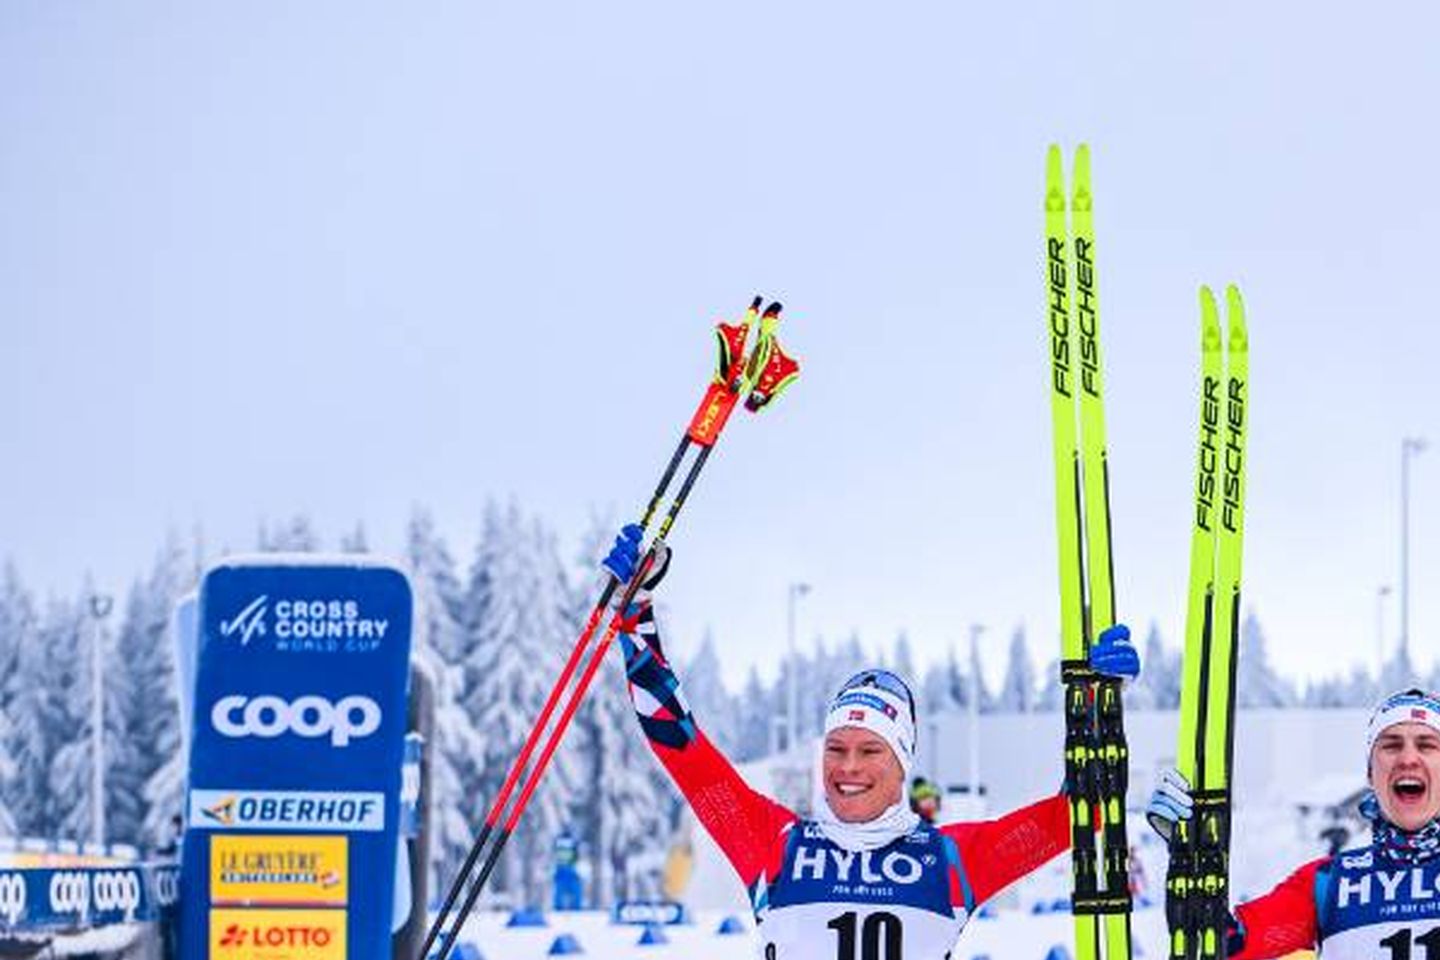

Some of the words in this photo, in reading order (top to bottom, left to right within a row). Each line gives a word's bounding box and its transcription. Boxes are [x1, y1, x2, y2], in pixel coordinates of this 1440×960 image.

[1048, 236, 1072, 399] FISCHER
[1075, 236, 1101, 399] FISCHER
[1197, 375, 1220, 533] FISCHER
[1222, 376, 1246, 533] FISCHER
[275, 601, 359, 619] CROSS
[275, 619, 389, 638] COUNTRY
[211, 695, 382, 747] coop
[239, 798, 376, 823] OBERHOF
[792, 847, 922, 884] HYLO
[252, 926, 331, 947] LOTTO
